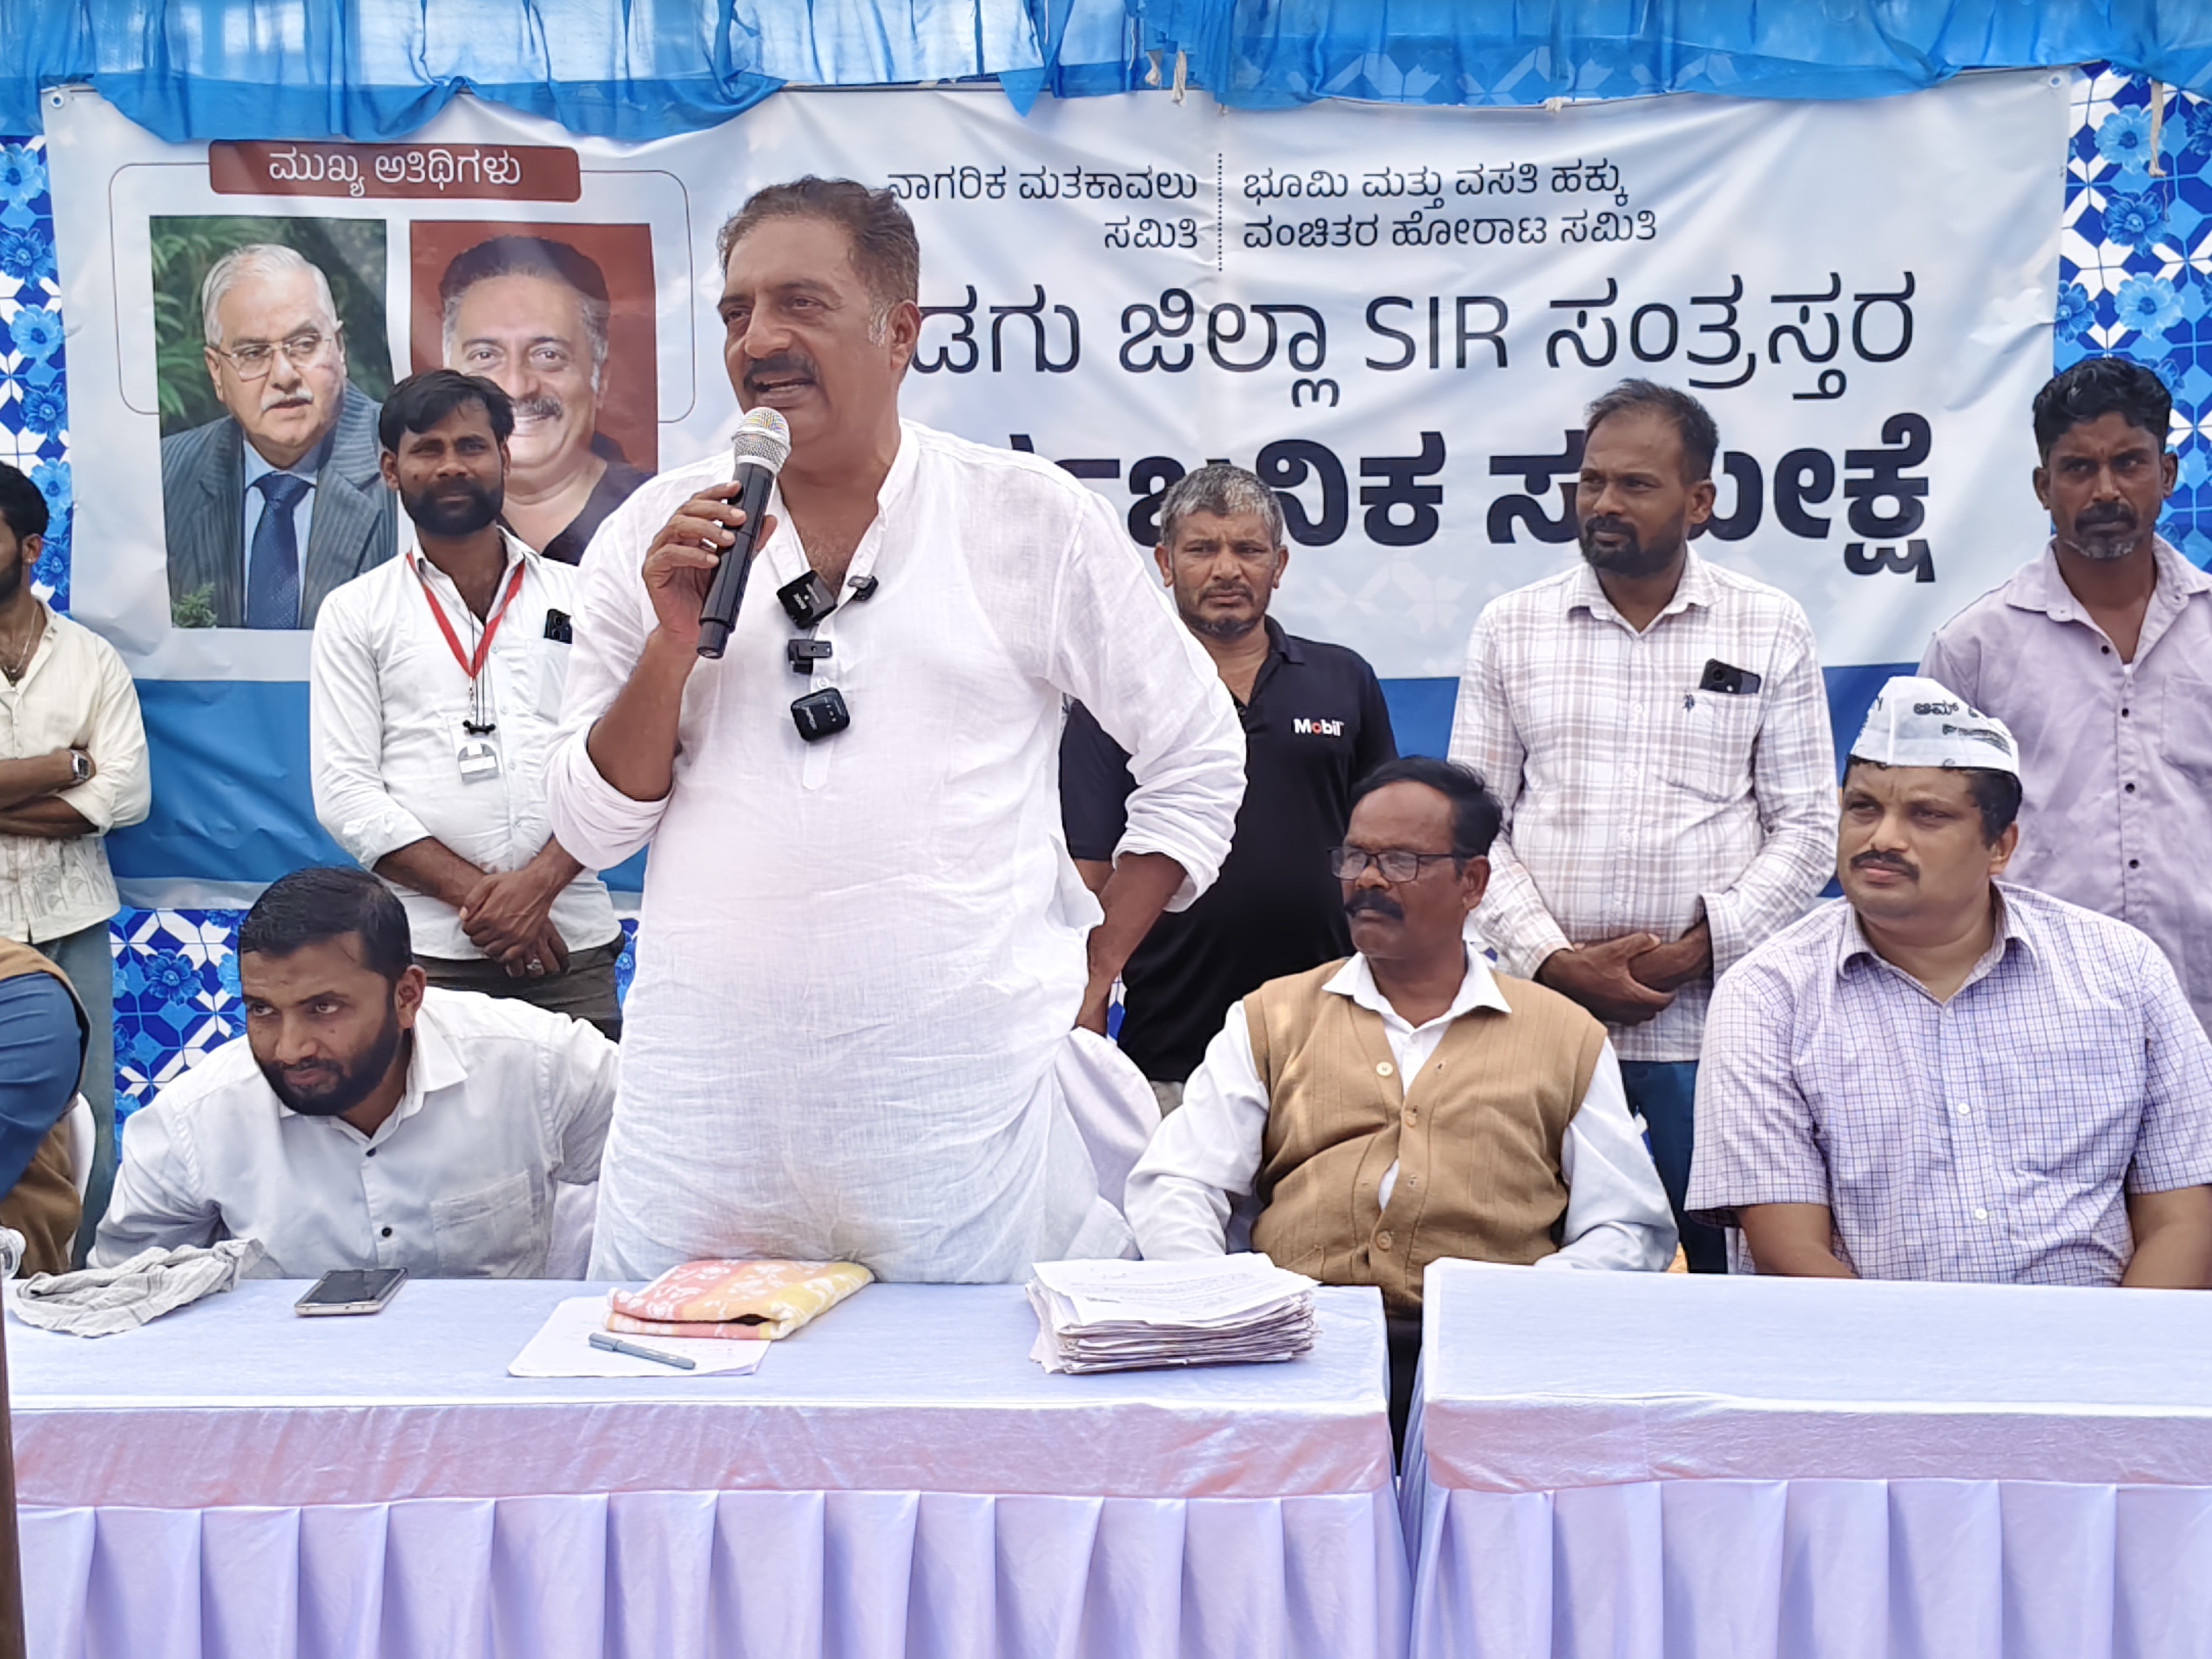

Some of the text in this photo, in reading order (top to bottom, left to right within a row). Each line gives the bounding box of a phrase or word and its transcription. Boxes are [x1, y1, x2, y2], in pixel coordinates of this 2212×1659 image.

[269, 146, 521, 197] ಮುಖ್ಯ ಅತಿಥಿಗಳು
[888, 165, 1197, 199] ನಾಗರಿಕ ಮತಕಾವಲು
[1244, 158, 1629, 210] ಭೂಮಿ ಮತ್ತು ವಸತಿ ಹಕ್ಕು
[1105, 215, 1198, 248] ಸಮಿತಿ
[1244, 209, 1656, 248] ವಂಚಿತರ ಹೋರಾಟ ಸಮಿತಿ
[911, 271, 1916, 408] ಡಗು ಜಿಲ್ಲಾ SIR ಸಂತ್ರಸ್ತರ
[1293, 718, 1343, 737] Mobil
